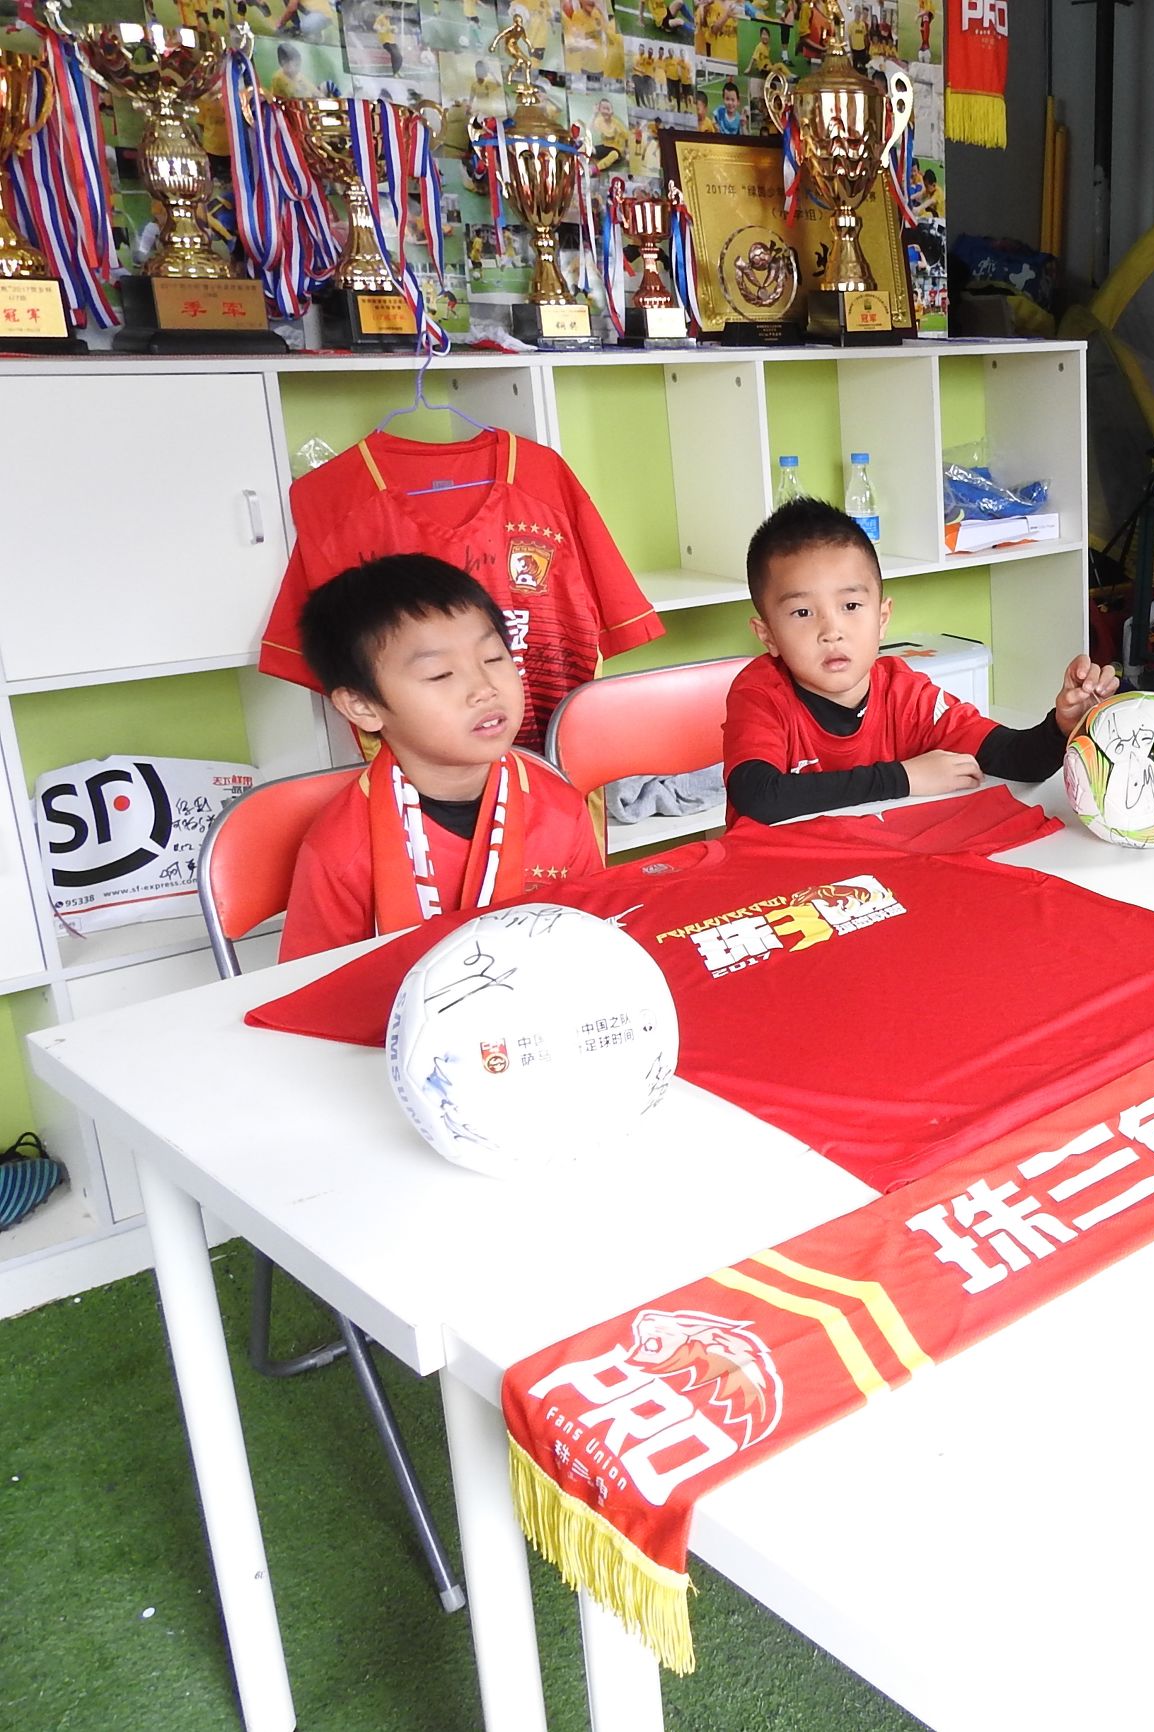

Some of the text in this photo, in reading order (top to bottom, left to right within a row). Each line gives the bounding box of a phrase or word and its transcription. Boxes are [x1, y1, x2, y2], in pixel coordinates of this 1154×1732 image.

[65, 894, 95, 908] 95338
[712, 951, 771, 979] 2017
[584, 1027, 636, 1053] 足球时间
[545, 1406, 584, 1442] Fans
[585, 1437, 628, 1491] Union
